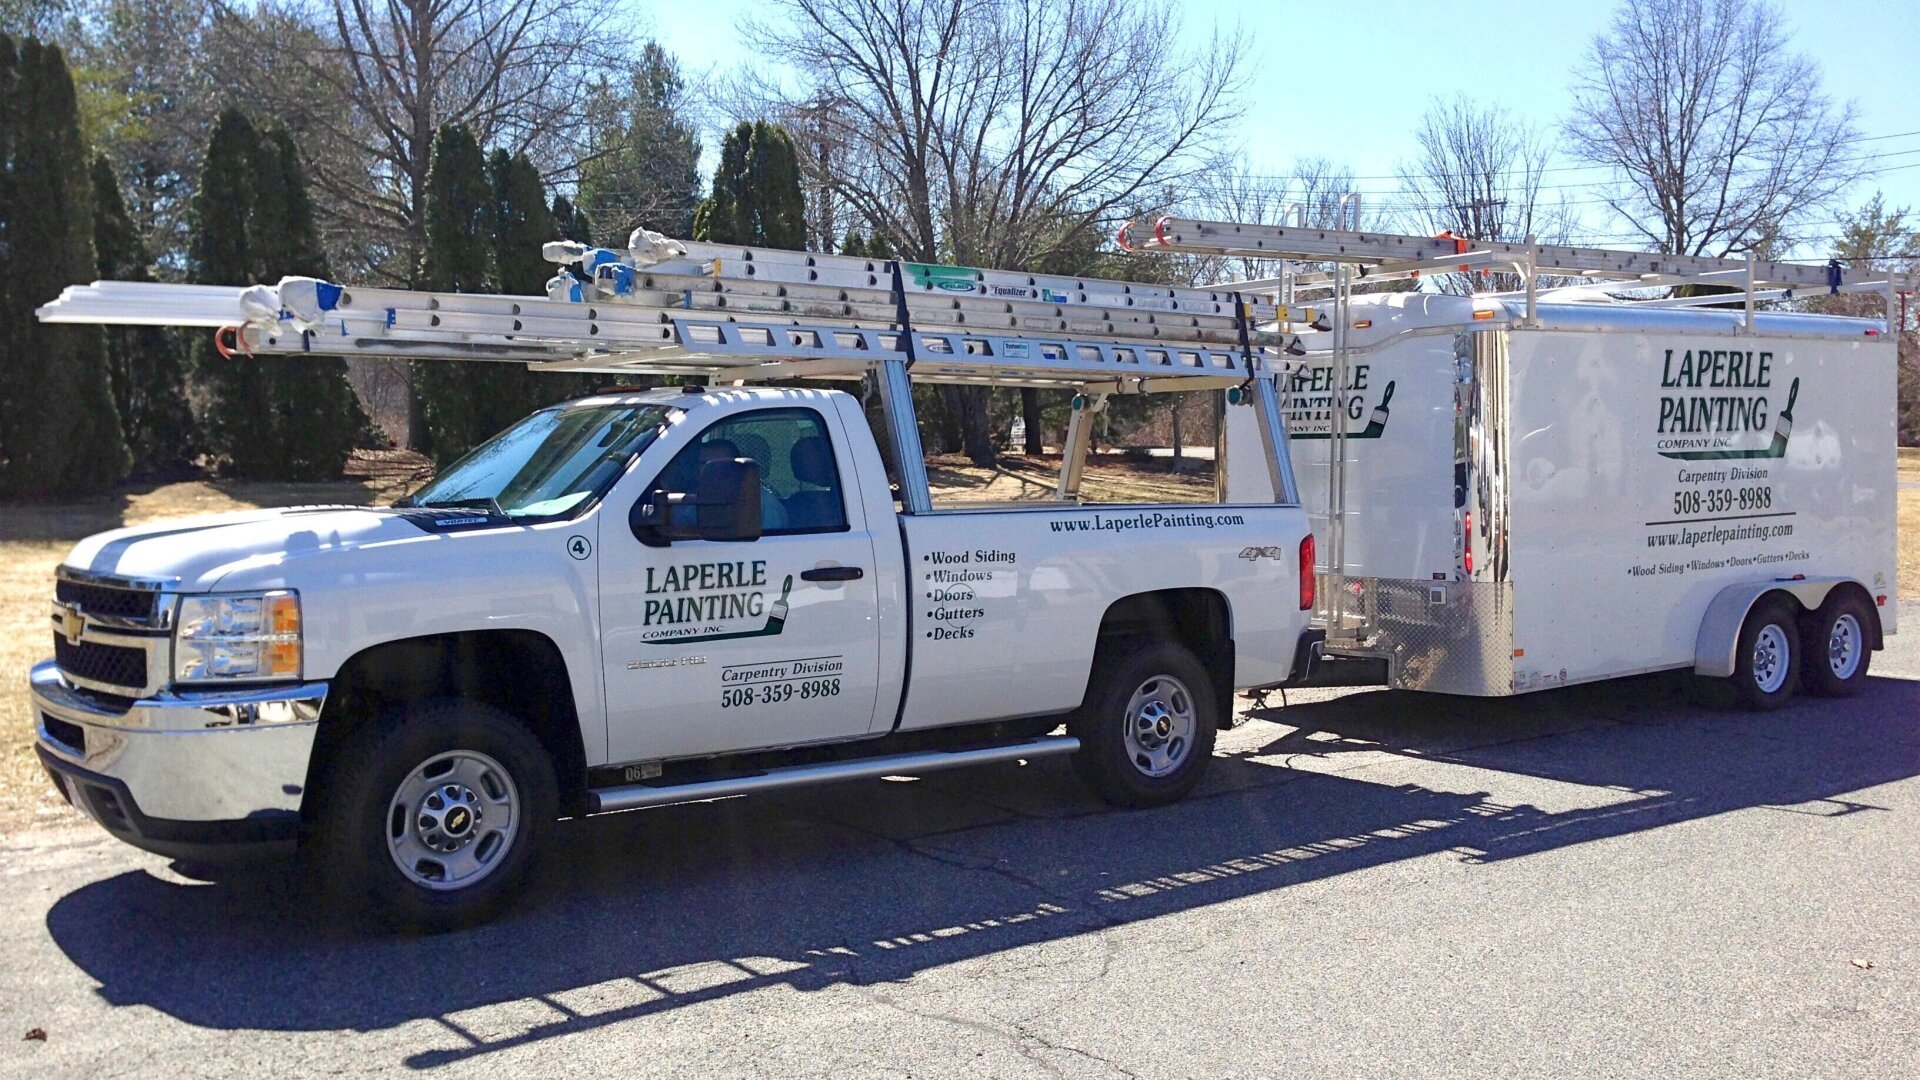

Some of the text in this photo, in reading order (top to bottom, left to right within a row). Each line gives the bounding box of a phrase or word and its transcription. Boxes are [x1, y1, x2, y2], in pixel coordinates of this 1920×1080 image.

[994, 286, 1026, 297] Equalizer
[1661, 349, 1773, 388] LAPERLE
[1282, 396, 1364, 420] INTIG
[1657, 396, 1768, 433] PAINTING
[1657, 438, 1710, 449] COMPANY
[1678, 467, 1768, 485] Carpentry Division
[1673, 486, 1772, 515] 508-359-8988
[1050, 513, 1244, 532] www.LaperlePainting.com
[1647, 522, 1793, 548] www.laperlepainting.com
[572, 540, 585, 554] 4
[931, 549, 1016, 565] Wood Siding
[1632, 551, 1810, 576] Wood Siding Windows Doors Gutters Decks
[645, 560, 767, 594] LAPERLE
[933, 569, 993, 583] Windows
[934, 589, 973, 602] Doors
[643, 591, 763, 626] PAINTING
[934, 607, 984, 620] Gutters
[642, 627, 700, 639] COMPANY
[934, 626, 974, 640] Decks
[722, 659, 842, 683] Carpentry Division
[721, 678, 841, 708] 508-359-8988
